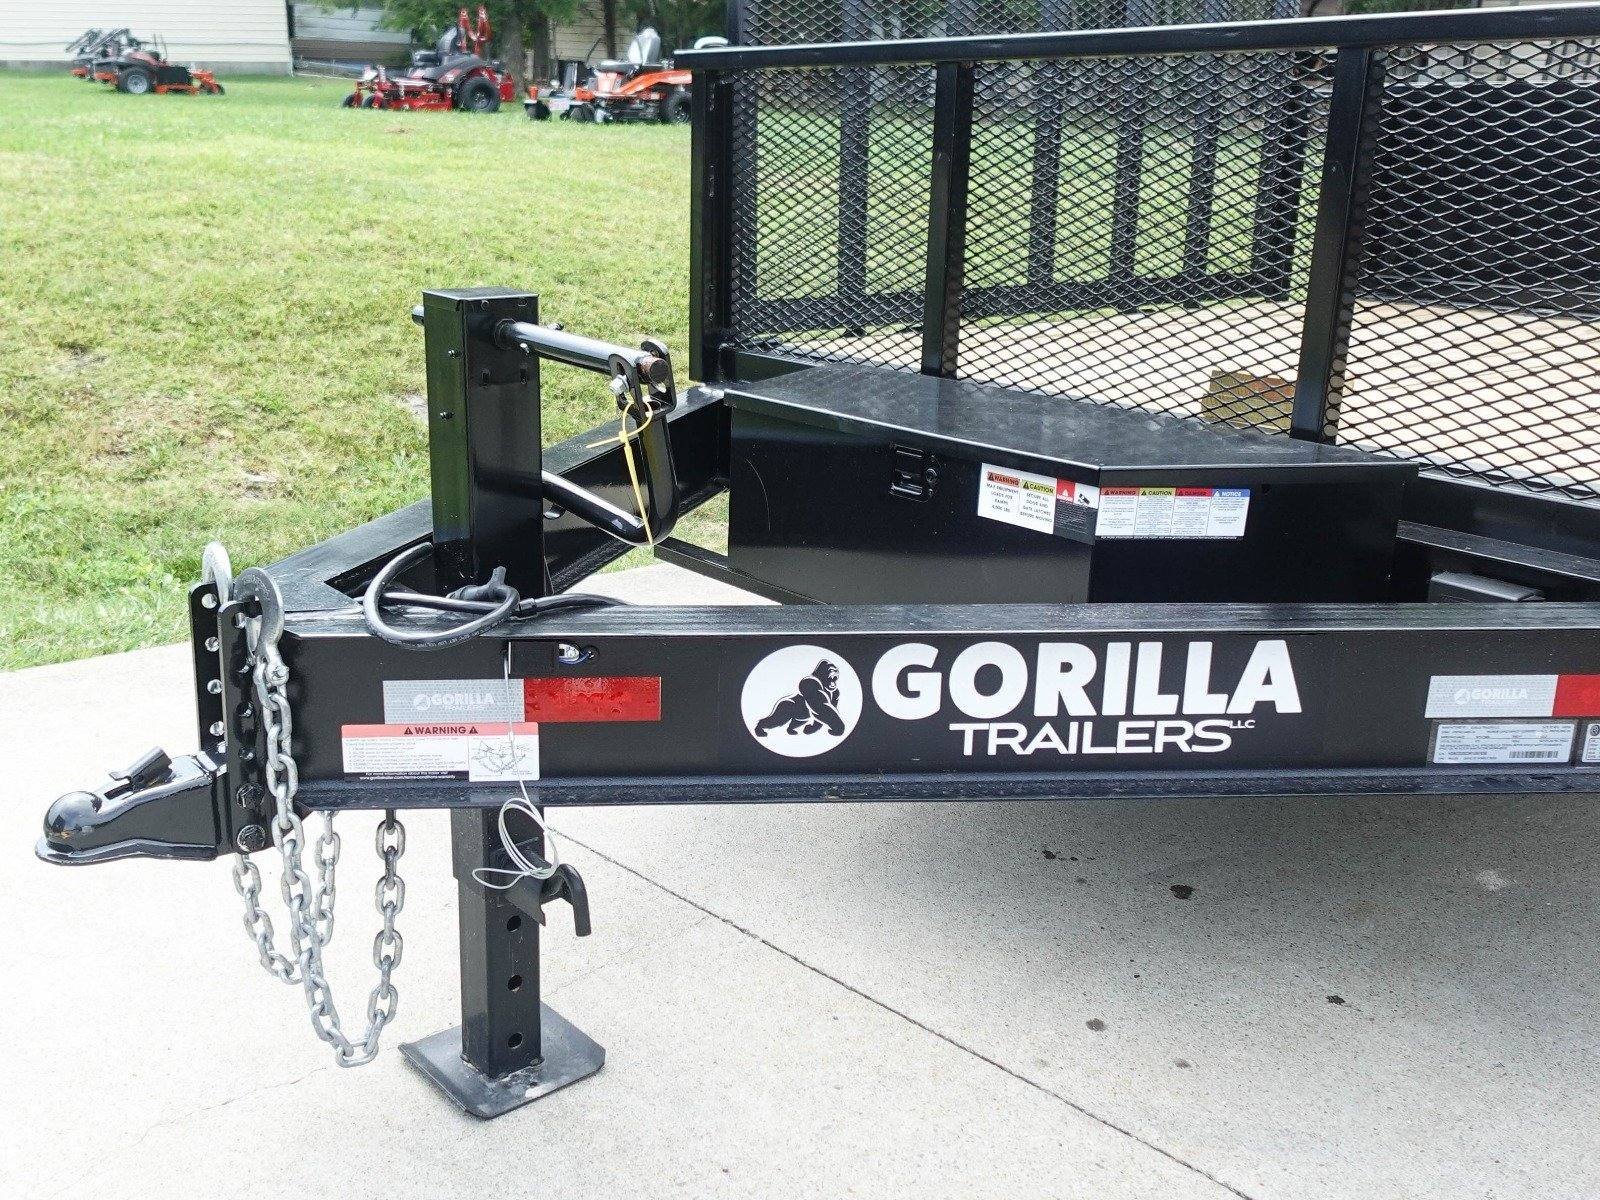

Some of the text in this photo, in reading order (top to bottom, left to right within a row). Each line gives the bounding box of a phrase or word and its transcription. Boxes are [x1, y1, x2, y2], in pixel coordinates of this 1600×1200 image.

[994, 475, 1020, 486] WARNING
[1029, 483, 1054, 494] CAUTION
[871, 639, 1303, 721] GORILLA
[430, 692, 494, 706] GORILLA
[1471, 687, 1528, 701] GORILLA
[414, 725, 468, 735] WARNING
[949, 719, 1256, 757] TRAILERS LLC
